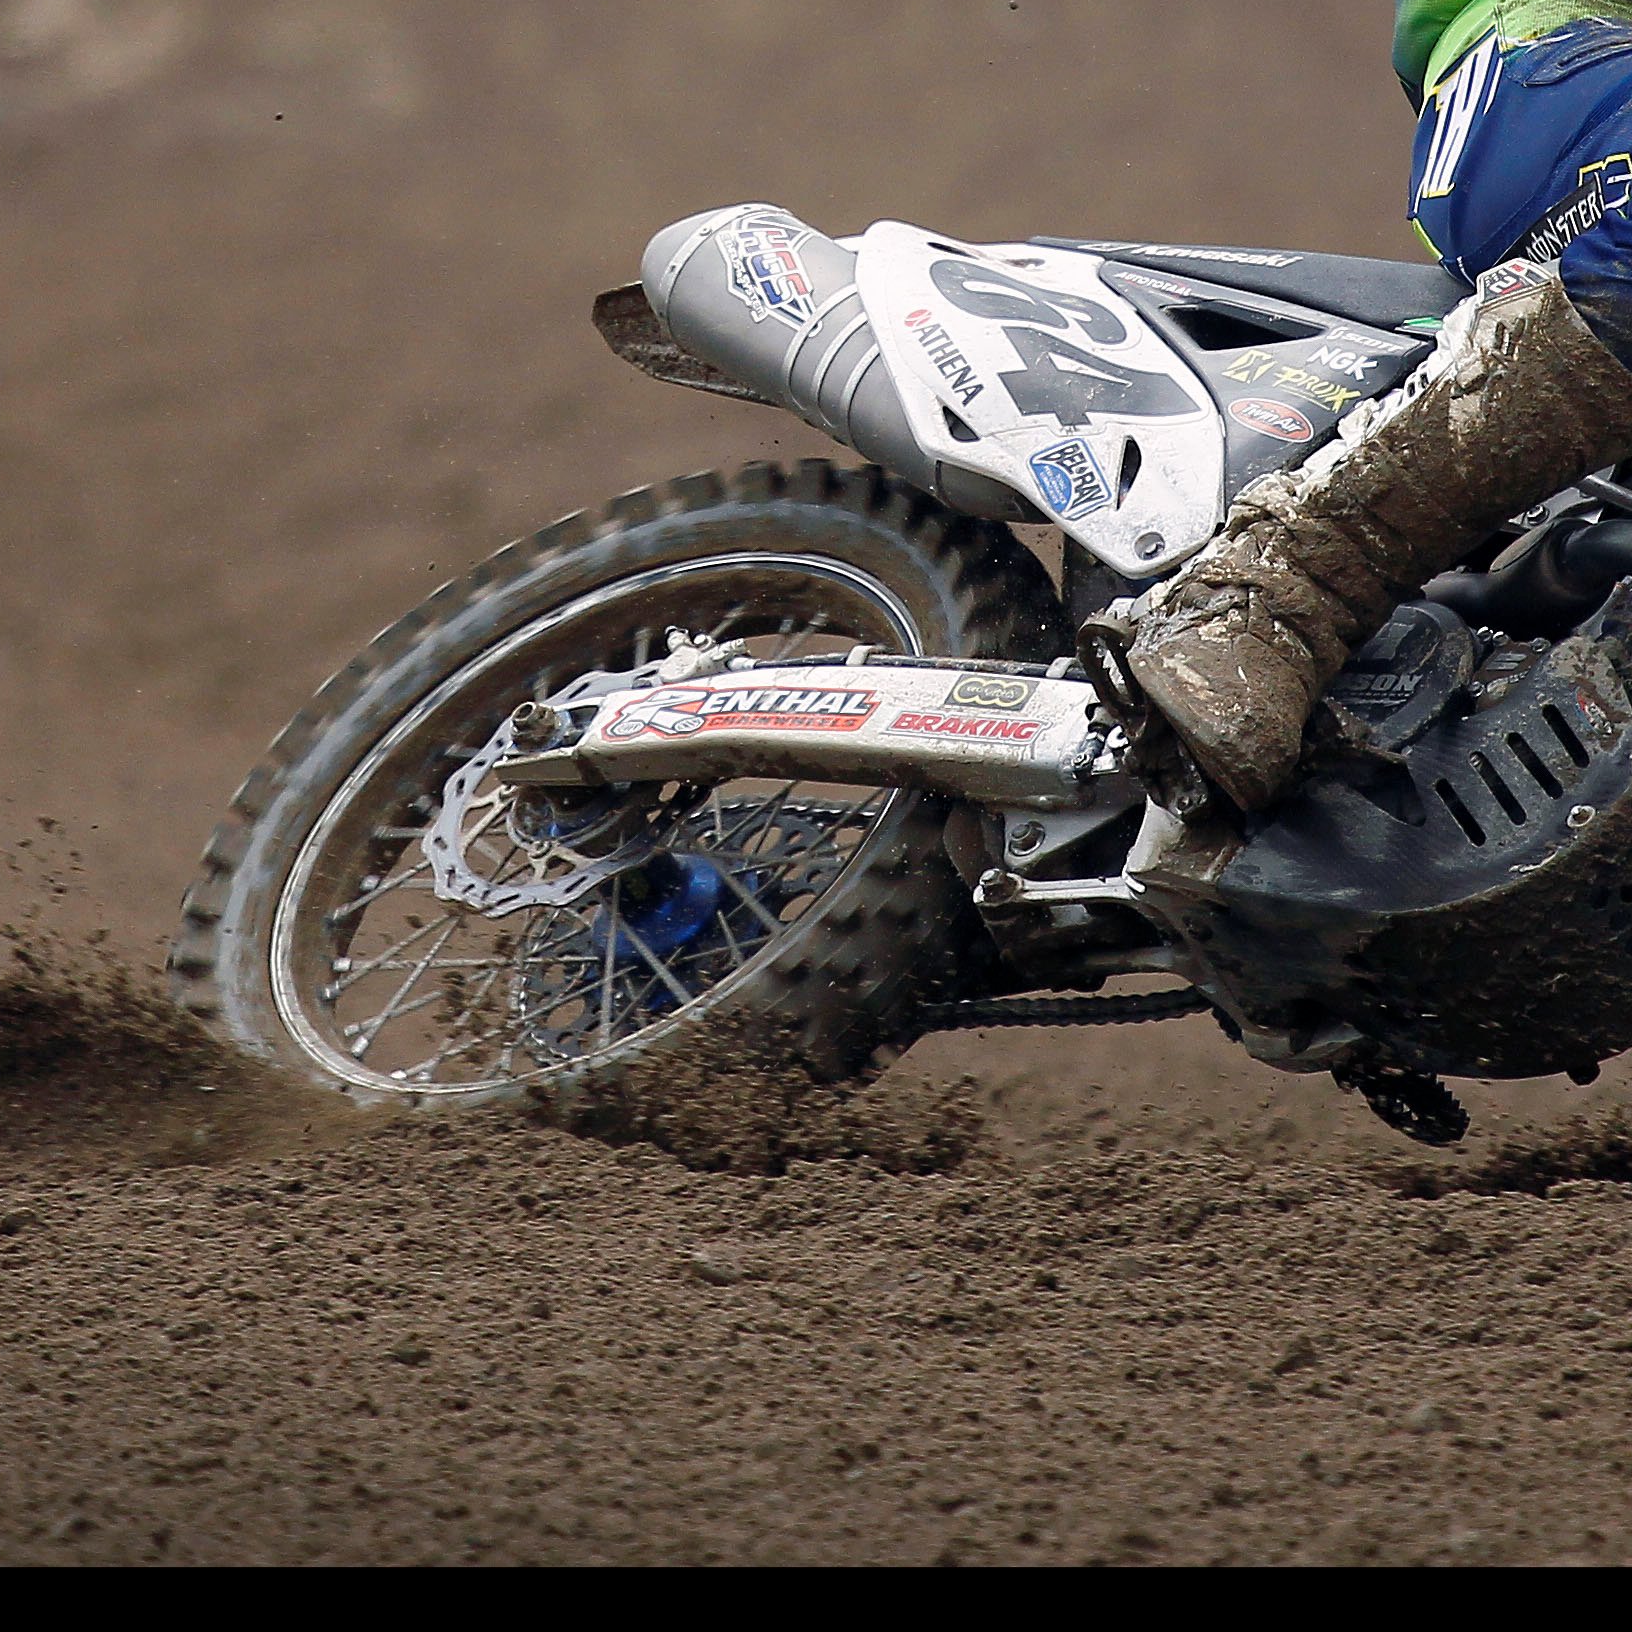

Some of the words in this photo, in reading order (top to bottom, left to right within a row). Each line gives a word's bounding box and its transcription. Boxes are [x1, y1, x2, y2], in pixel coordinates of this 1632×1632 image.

[737, 228, 809, 308] HGS
[1131, 245, 1304, 269] Kawasaki
[913, 322, 985, 407] ATHENA
[1306, 345, 1378, 382] NGK
[613, 688, 871, 735] RENTHAL
[892, 713, 1041, 741] BRAKING
